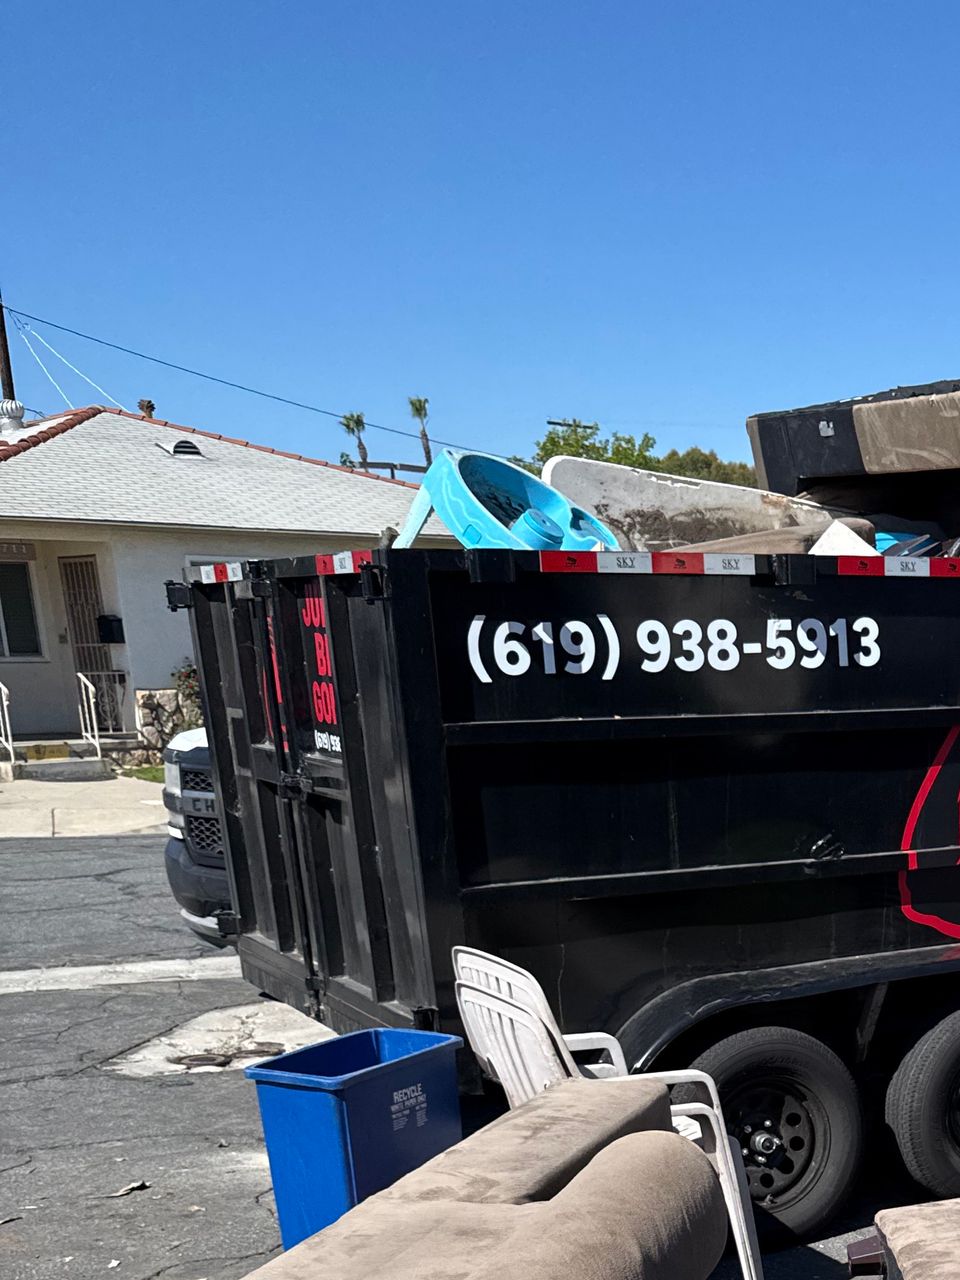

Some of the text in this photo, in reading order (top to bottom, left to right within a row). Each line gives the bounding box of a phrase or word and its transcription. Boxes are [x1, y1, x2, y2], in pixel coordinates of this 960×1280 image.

[616, 556, 635, 567] SKY
[722, 558, 740, 567] SKY
[900, 561, 916, 570] SKY
[467, 614, 881, 683] (619) 938-5913
[393, 1083, 423, 1104] RECYCLE
